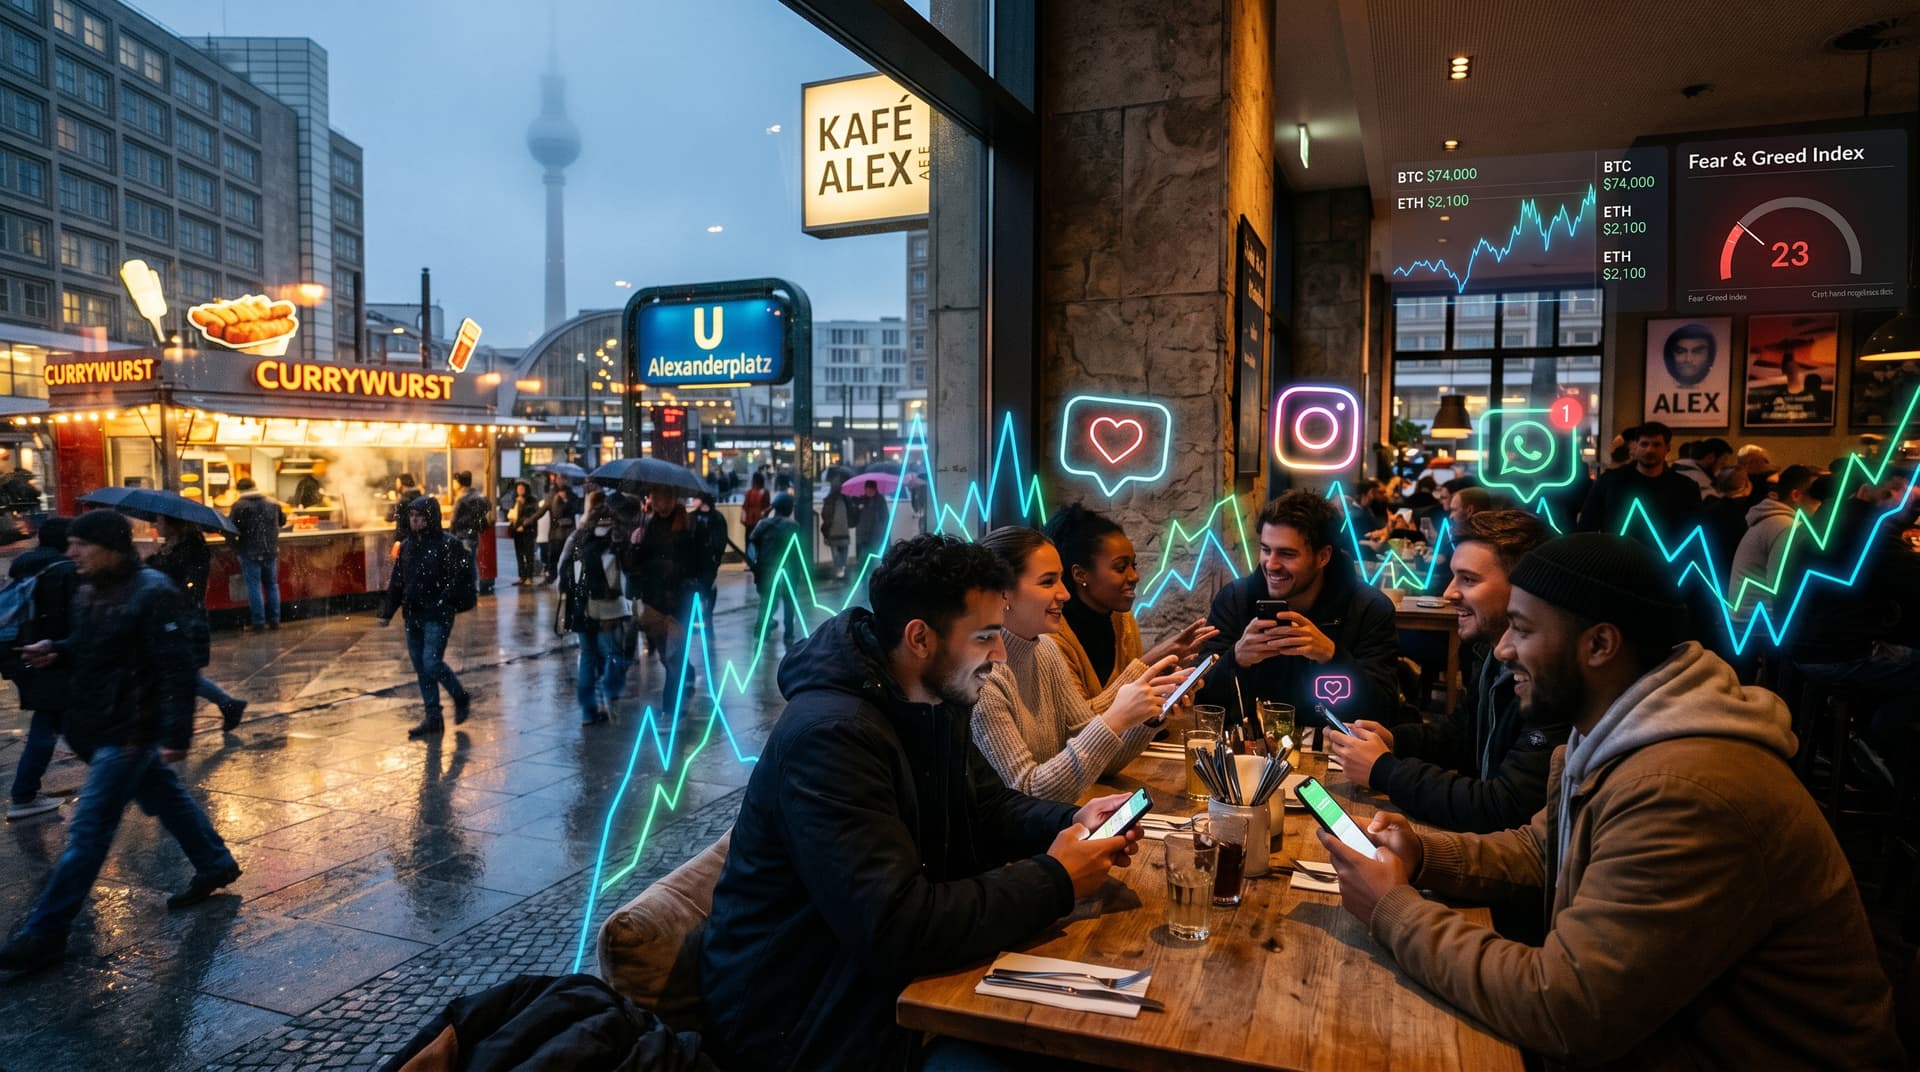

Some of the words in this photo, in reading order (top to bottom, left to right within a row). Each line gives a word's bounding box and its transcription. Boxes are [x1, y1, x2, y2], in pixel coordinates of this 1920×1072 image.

[819, 94, 913, 152] KAFÉ
[1603, 160, 1632, 174] BTC
[1688, 153, 1728, 170] Fear
[1732, 151, 1747, 167] &
[1751, 147, 1807, 166] Greed
[1813, 145, 1865, 163] Index
[818, 149, 913, 196] ALEX
[1397, 170, 1424, 184] BTC
[1603, 175, 1655, 192] $74,000
[1397, 196, 1424, 210] ETH
[1427, 193, 1469, 209] $2,100
[1603, 205, 1632, 218] ETH
[1602, 221, 1647, 236] $2,100
[1603, 251, 1632, 263] ETH
[1770, 240, 1809, 268] 23
[1602, 267, 1647, 282] $2,100
[1706, 293, 1728, 302] Greed
[693, 305, 724, 350] U
[43, 357, 155, 387] CURRYWURST
[647, 351, 773, 380] Alexanderplatz
[254, 359, 456, 401] CURRYWURST
[1653, 392, 1721, 414] ALEX
